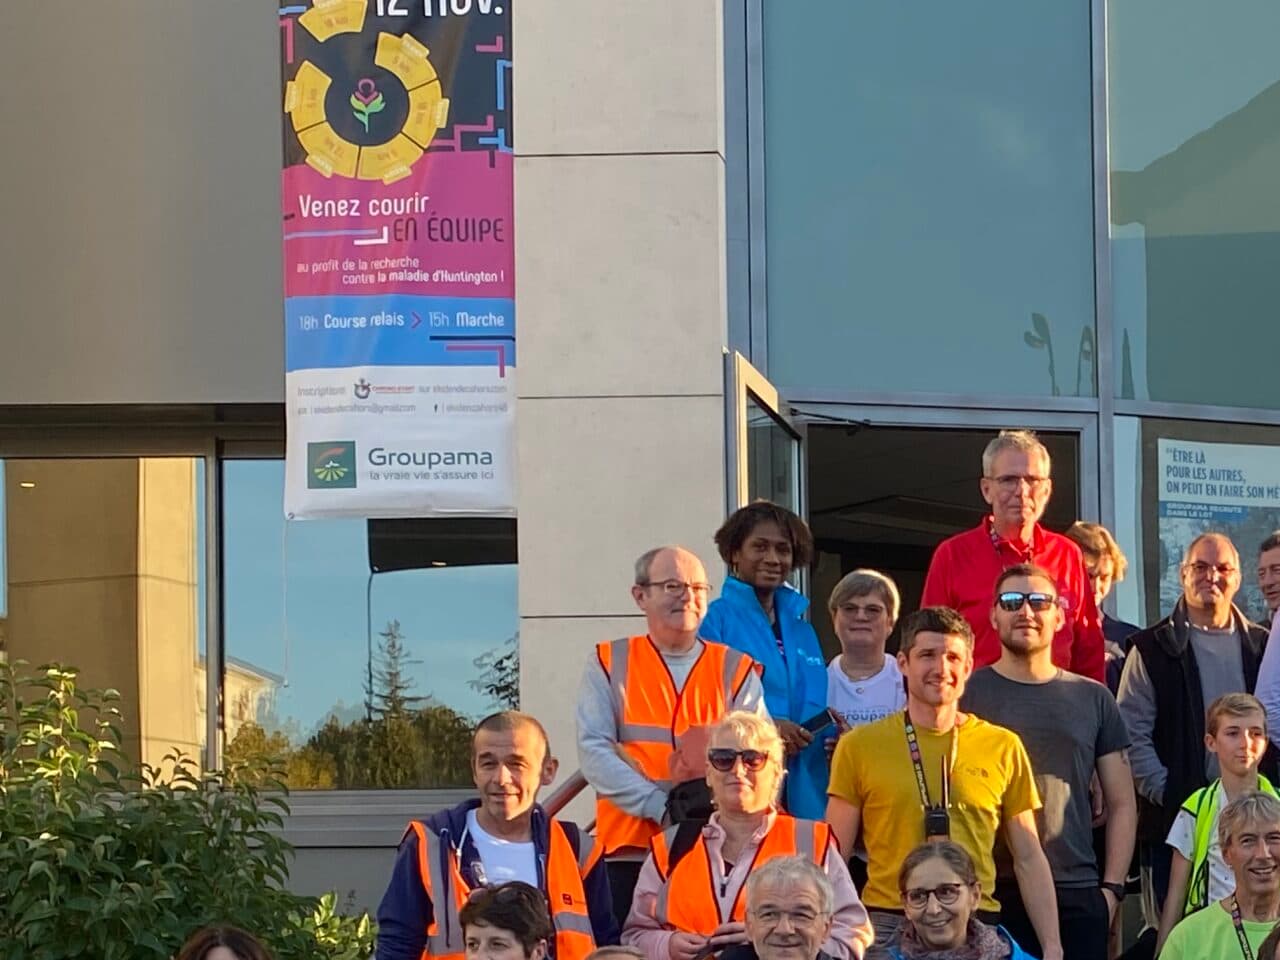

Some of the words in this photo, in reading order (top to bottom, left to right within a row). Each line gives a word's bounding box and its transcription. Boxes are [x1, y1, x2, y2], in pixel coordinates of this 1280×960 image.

[299, 195, 361, 218] Venez
[369, 192, 430, 216] courir
[427, 211, 505, 243] ÉQUIPE
[297, 263, 309, 273] au
[312, 260, 339, 274] profit
[342, 259, 355, 271] de
[359, 258, 368, 271] la
[371, 256, 420, 270] recherche
[342, 273, 375, 284] contre
[378, 272, 387, 282] la
[389, 269, 430, 282] maladie
[432, 270, 498, 285] d'Huntington
[300, 315, 318, 330] 18h
[324, 314, 367, 328] Course
[370, 311, 405, 327] relais
[429, 311, 449, 327] 15h
[456, 312, 505, 327] Marche
[368, 447, 493, 470] Groupama
[370, 471, 380, 480] la
[383, 471, 411, 480] vraie
[414, 471, 431, 480] vie
[433, 471, 478, 480] s'assure
[481, 471, 494, 480] ici
[1166, 465, 1191, 478] POUR
[1192, 467, 1207, 480] LES
[1166, 481, 1180, 493] ON
[1182, 482, 1203, 495] PEUT
[1206, 484, 1217, 496] EN
[1219, 485, 1244, 497] FAIRE
[1246, 486, 1265, 498] SON
